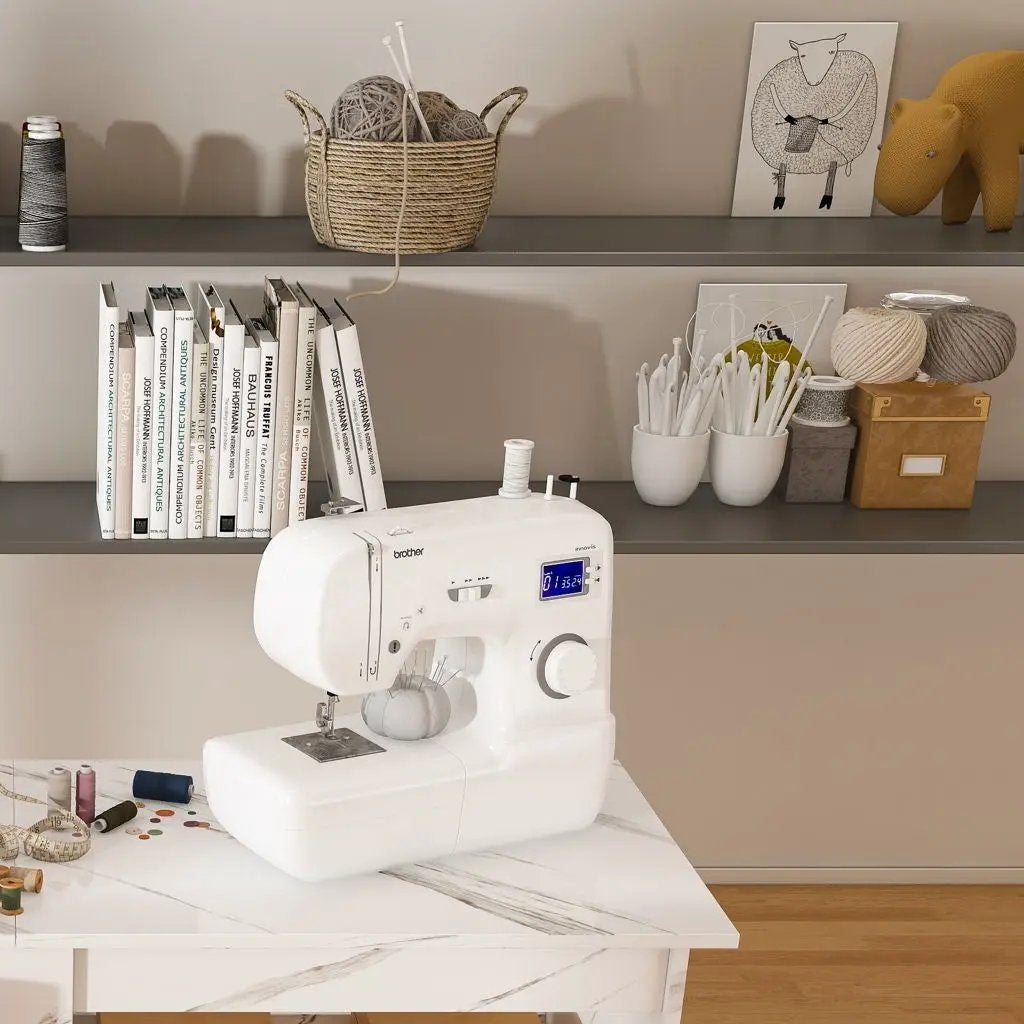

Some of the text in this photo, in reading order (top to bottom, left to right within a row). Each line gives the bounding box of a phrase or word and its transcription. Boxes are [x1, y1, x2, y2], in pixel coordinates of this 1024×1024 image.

[210, 348, 220, 381] Design
[232, 367, 241, 390] JOSEF
[330, 367, 342, 389] JOSEF
[353, 367, 365, 389] JOSEF
[143, 376, 152, 398] JOSEF
[245, 374, 257, 438] BAUHAUS
[142, 399, 151, 441] HOFFMANN
[155, 326, 168, 512] COMPENDIUM ARCHITECTURAL ANTIQUES
[175, 339, 188, 525] COMPENDIUM ARCHITECTURAL ANTIQUES
[231, 390, 240, 434] HOFFMANN
[297, 317, 315, 521] THE UNCOMMON LIFE OF COMMON OBJECT
[334, 389, 349, 432] HOFFMANN
[357, 389, 372, 432] HOFFMANN
[194, 352, 208, 530] THE UNCOMMON LIFE OF COMMON OBJECTS
[258, 355, 274, 514] FRANCOIS TRUFFAT The Complete Films
[105, 466, 113, 512] ANTIQUES
[277, 452, 289, 511] SCARPA
[393, 547, 425, 559] brother
